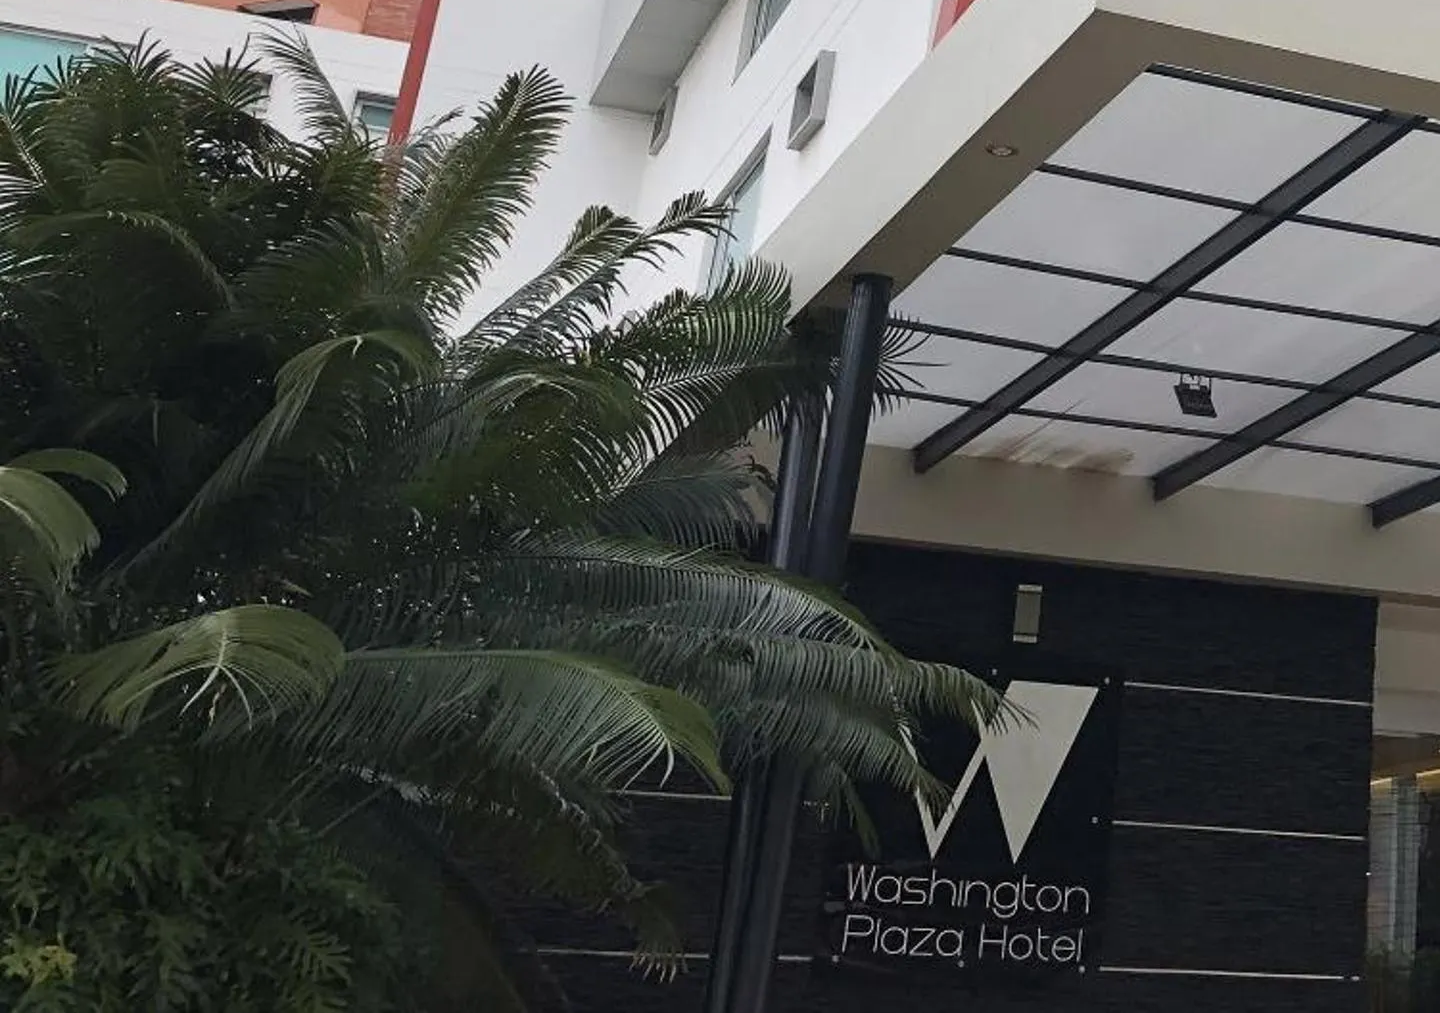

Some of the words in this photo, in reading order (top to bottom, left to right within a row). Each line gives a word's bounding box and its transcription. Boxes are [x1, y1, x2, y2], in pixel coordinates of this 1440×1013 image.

[847, 863, 1090, 918] Washington
[841, 914, 964, 956] Plaza
[978, 923, 1084, 962] Hotel
